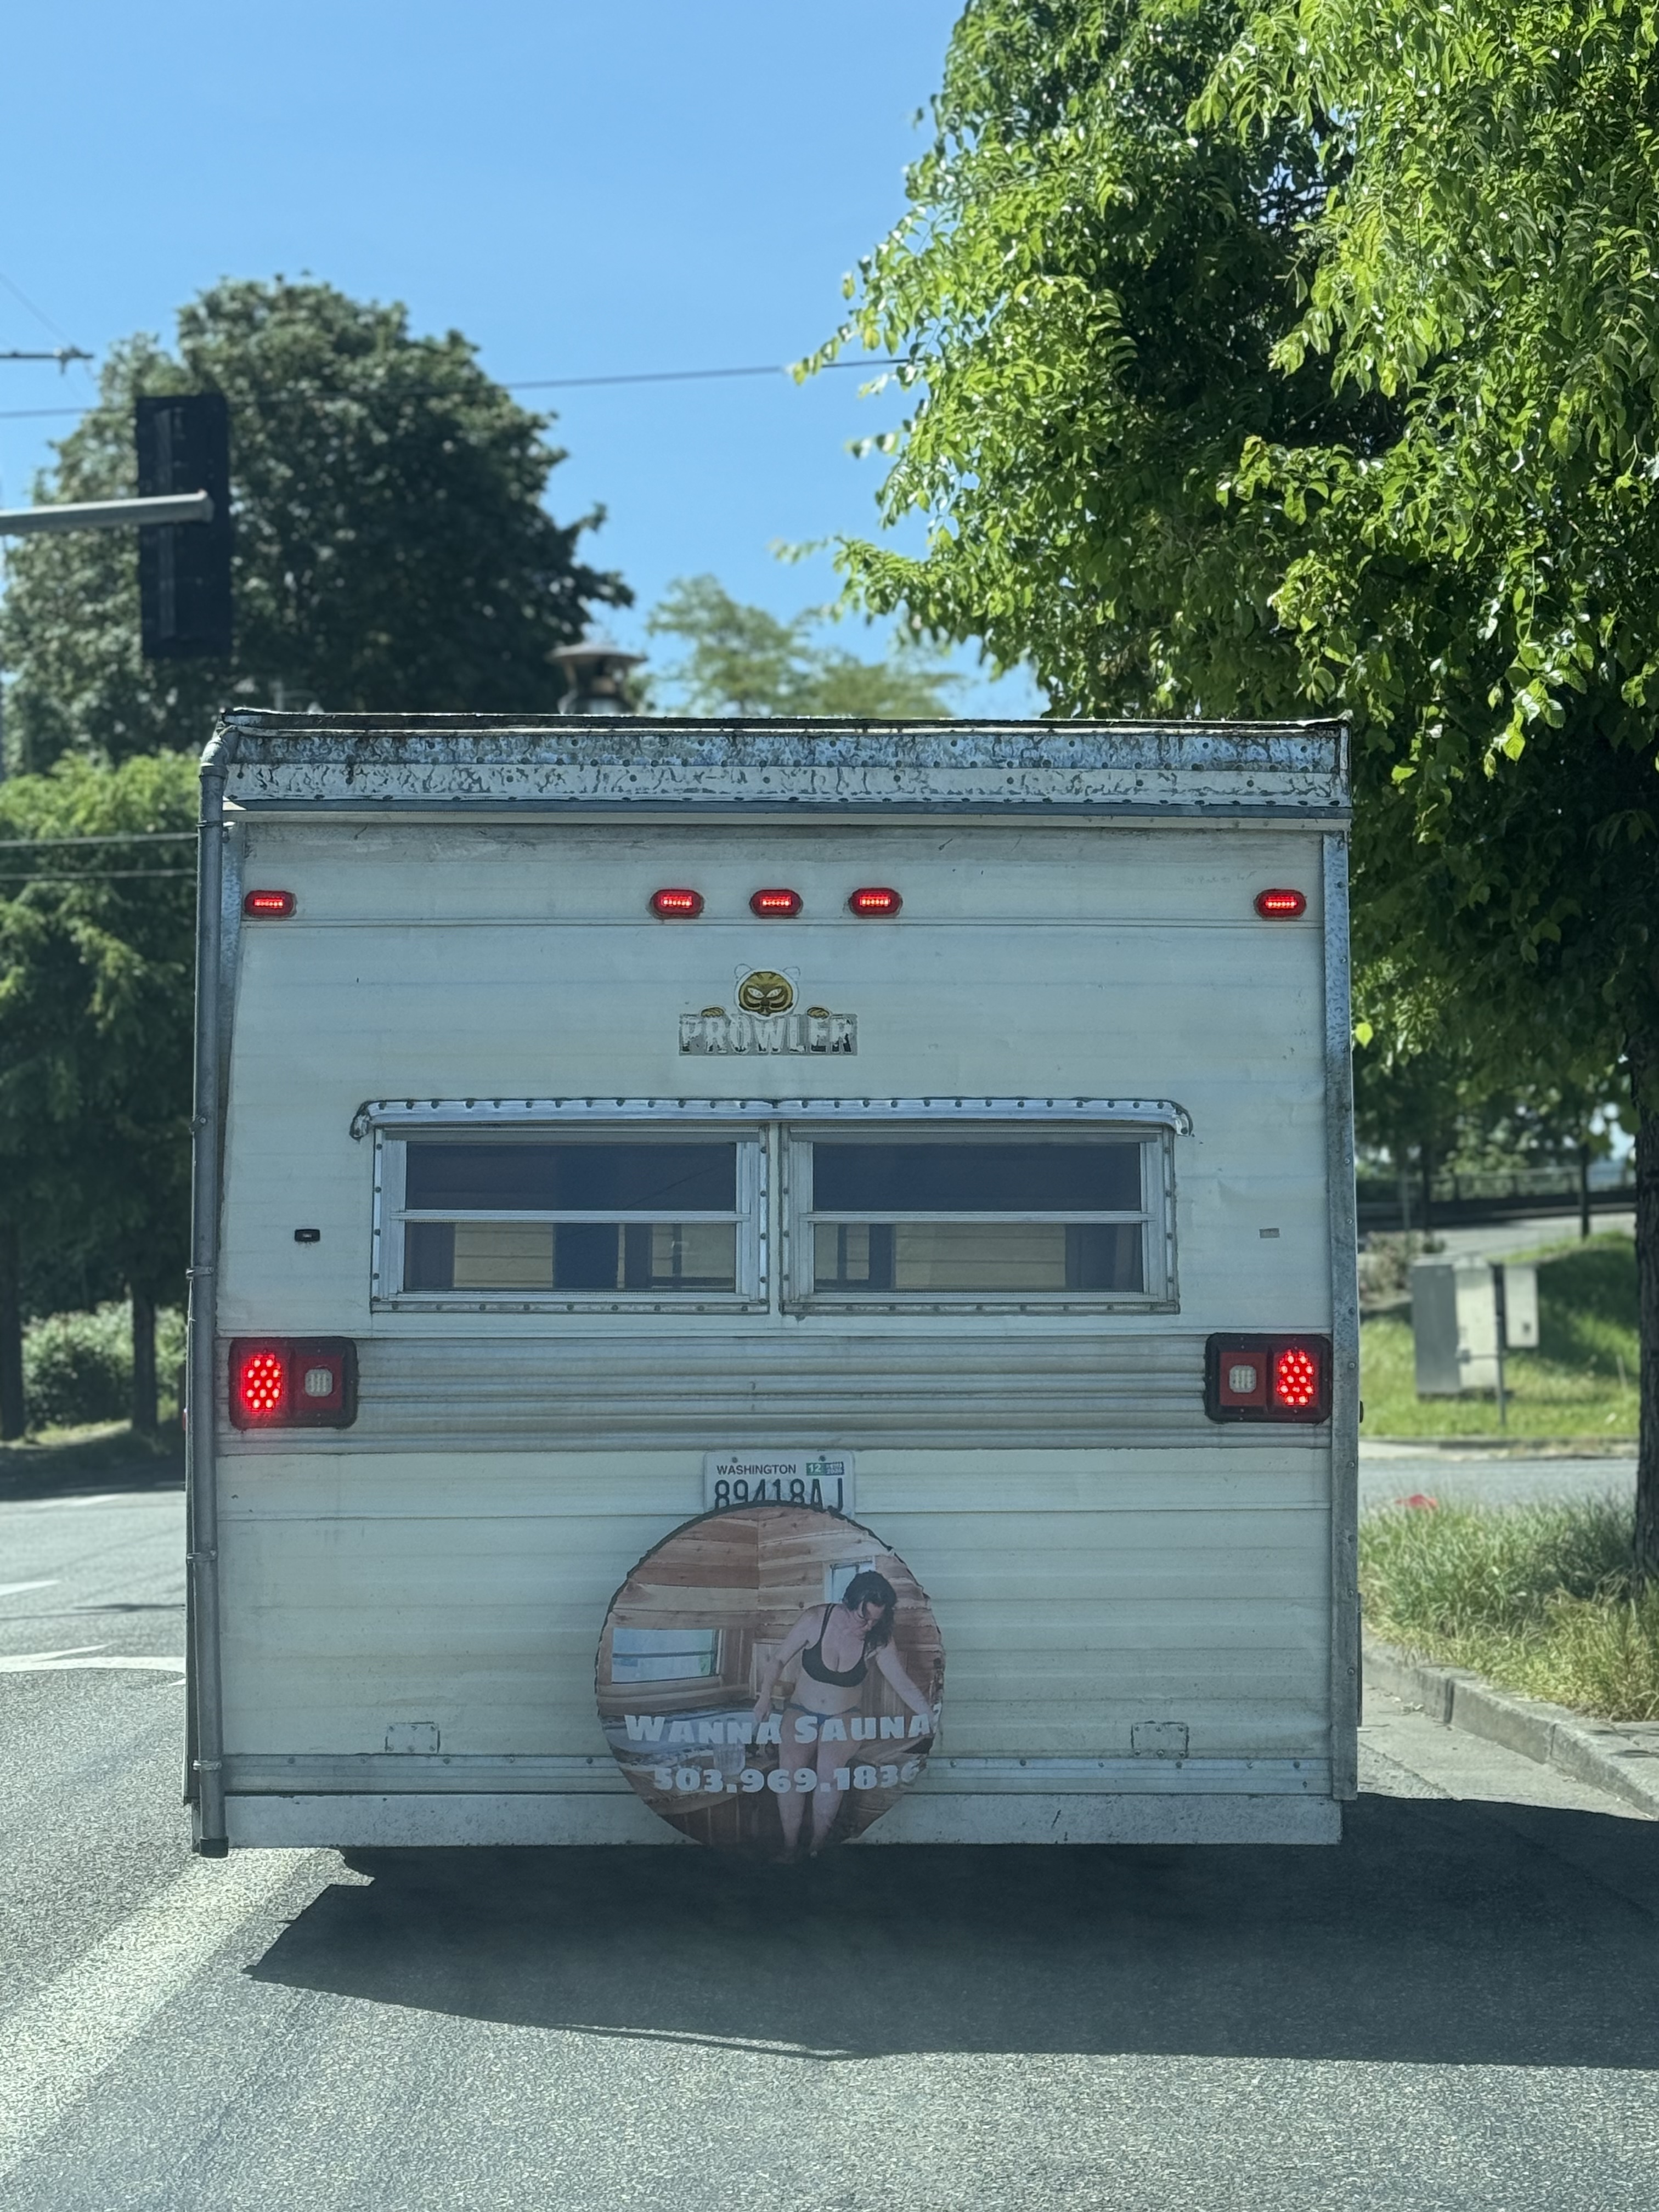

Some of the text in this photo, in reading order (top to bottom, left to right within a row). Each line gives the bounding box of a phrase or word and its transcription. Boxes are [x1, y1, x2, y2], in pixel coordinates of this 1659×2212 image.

[681, 1014, 852, 1053] PROWLER
[716, 1464, 796, 1475] WASHINGTON
[808, 1463, 821, 1473] 12
[624, 1713, 782, 1745] WANNA
